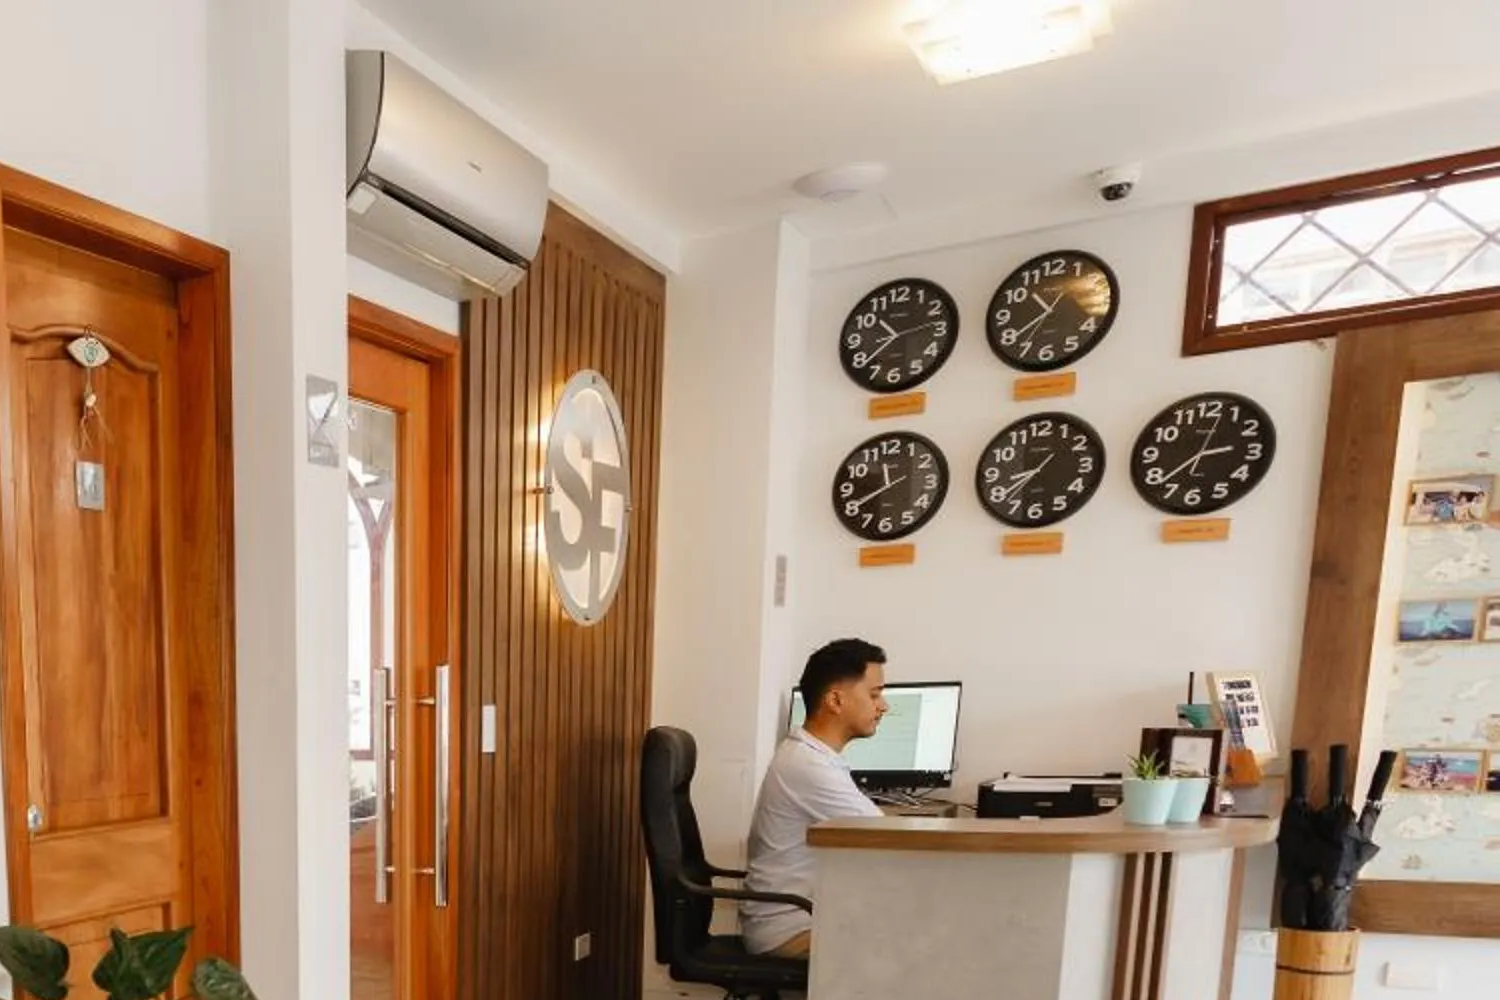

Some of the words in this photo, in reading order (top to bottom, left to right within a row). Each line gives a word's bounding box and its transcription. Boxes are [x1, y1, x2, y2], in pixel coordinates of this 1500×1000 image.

[1041, 259, 1066, 276] 12
[1073, 262, 1082, 276] 1
[1021, 269, 1040, 286] 11
[890, 286, 910, 302] 12
[917, 290, 924, 304] 1
[1005, 288, 1027, 304] 10
[870, 296, 886, 312] 11
[928, 300, 942, 316] 2
[856, 313, 876, 329] 10
[996, 309, 1011, 325] 9
[1079, 317, 1095, 332] 4
[933, 321, 947, 336] 3
[848, 334, 860, 349] 9
[1001, 328, 1017, 345] 8
[1064, 336, 1078, 352] 5
[924, 342, 938, 356] 4
[1020, 342, 1032, 358] 7
[1039, 345, 1054, 360] 6
[852, 352, 866, 368] 8
[909, 359, 923, 374] 5
[870, 365, 880, 380] 7
[887, 368, 900, 383] 6
[1198, 401, 1222, 417] 12
[1230, 406, 1239, 422] 1
[1174, 409, 1195, 425] 11
[1030, 421, 1052, 436] 12
[1060, 424, 1068, 438] 1
[1154, 426, 1178, 442] 10
[1241, 420, 1259, 436] 2
[1010, 430, 1027, 445] 11
[1072, 436, 1087, 451] 2
[863, 448, 878, 462] 11
[881, 440, 900, 455] 12
[908, 443, 914, 456] 1
[993, 447, 1015, 462] 10
[1143, 447, 1158, 463] 9
[1245, 443, 1262, 460] 3
[918, 453, 932, 468] 2
[1078, 458, 1092, 472] 3
[848, 463, 868, 478] 10
[984, 467, 999, 483] 9
[1145, 467, 1163, 485] 8
[1230, 464, 1249, 481] 4
[925, 474, 937, 489] 3
[1068, 478, 1084, 493] 4
[840, 482, 854, 498] 9
[990, 486, 1006, 502] 8
[1164, 483, 1179, 499] 7
[1184, 489, 1200, 505] 6
[1212, 482, 1228, 498] 5
[845, 501, 859, 516] 8
[913, 494, 929, 509] 4
[1008, 500, 1021, 514] 7
[1052, 495, 1067, 511] 5
[901, 511, 914, 524] 5
[1028, 504, 1042, 518] 6
[862, 514, 873, 528] 7
[878, 517, 892, 532] 6
